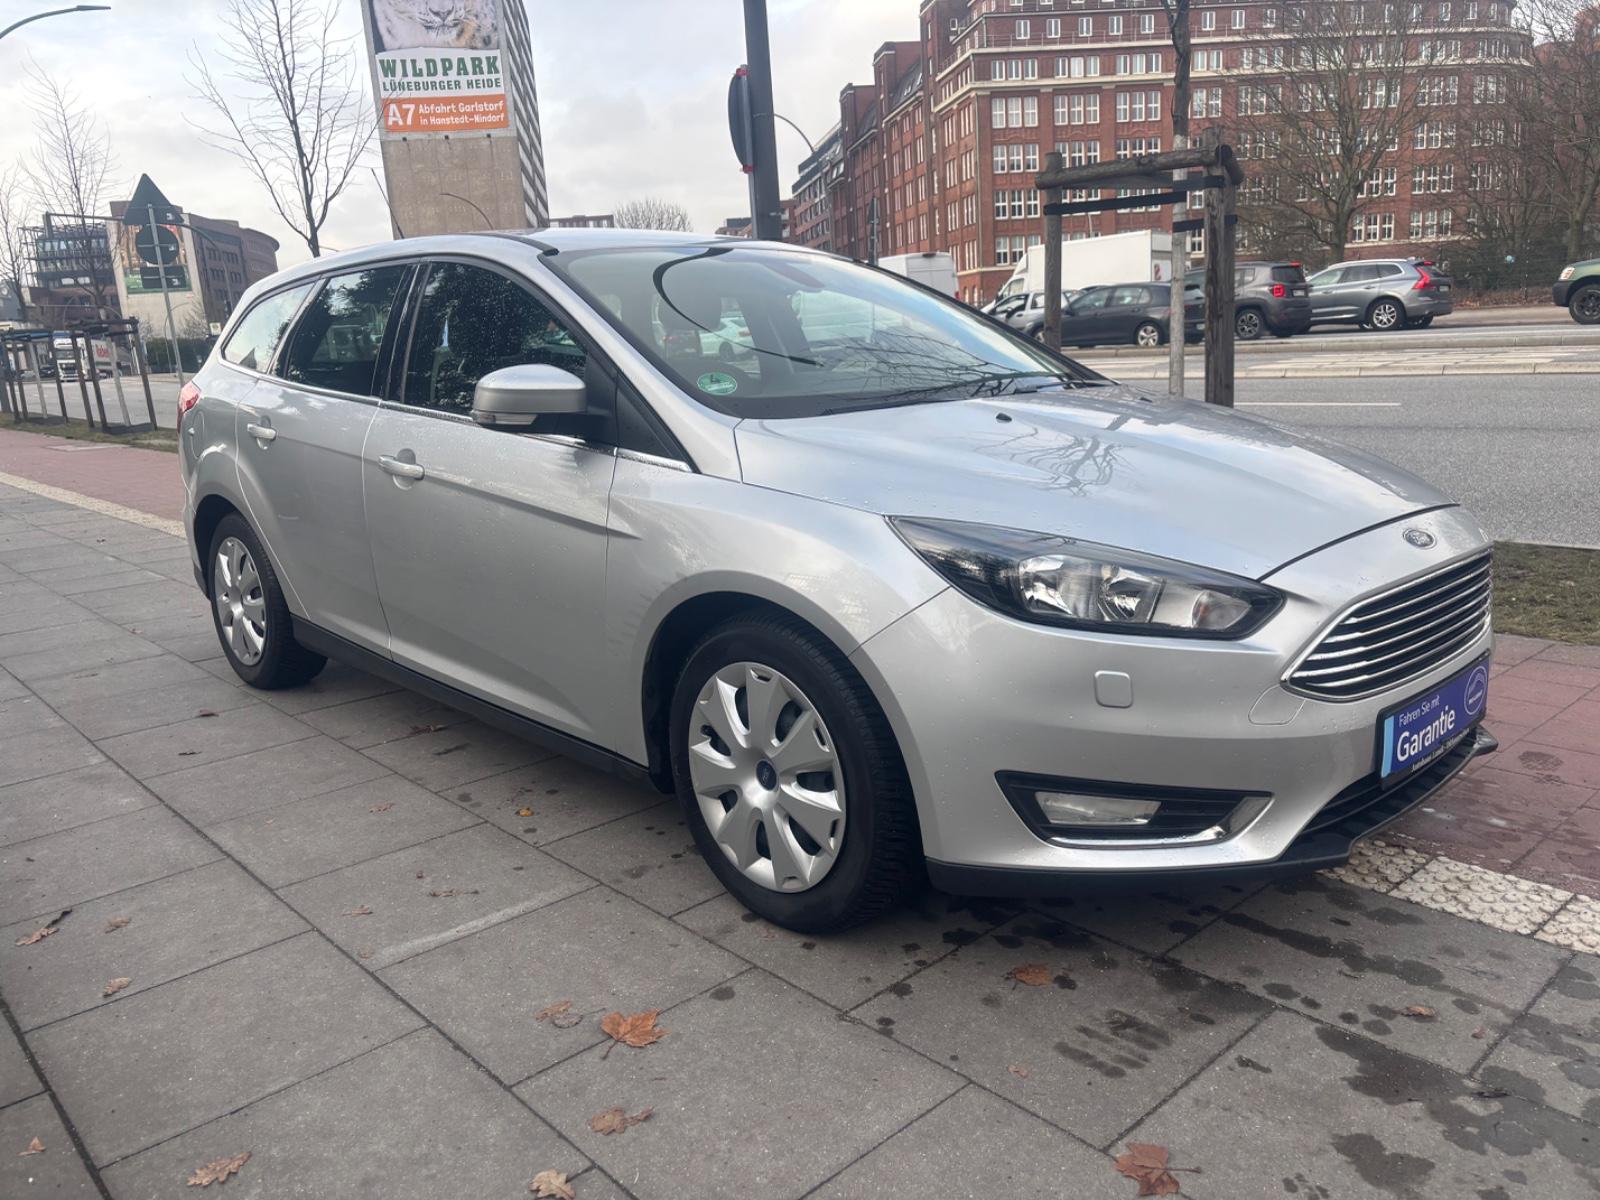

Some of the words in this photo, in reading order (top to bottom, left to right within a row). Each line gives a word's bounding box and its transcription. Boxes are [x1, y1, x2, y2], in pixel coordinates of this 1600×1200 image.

[379, 56, 500, 77] WILDPARK
[383, 79, 461, 91] LÜNEBURGER
[467, 78, 502, 89] HEIDE
[387, 103, 415, 126] A7
[419, 103, 457, 114] Abfahrt
[458, 100, 504, 112] Garlstorf
[420, 115, 428, 125] in
[429, 113, 505, 125] Hanstedt-Nindorf
[1399, 708, 1421, 728] Fahren
[1421, 700, 1431, 715] Sie
[1431, 694, 1440, 709] mit
[1397, 705, 1456, 761] Garantie
